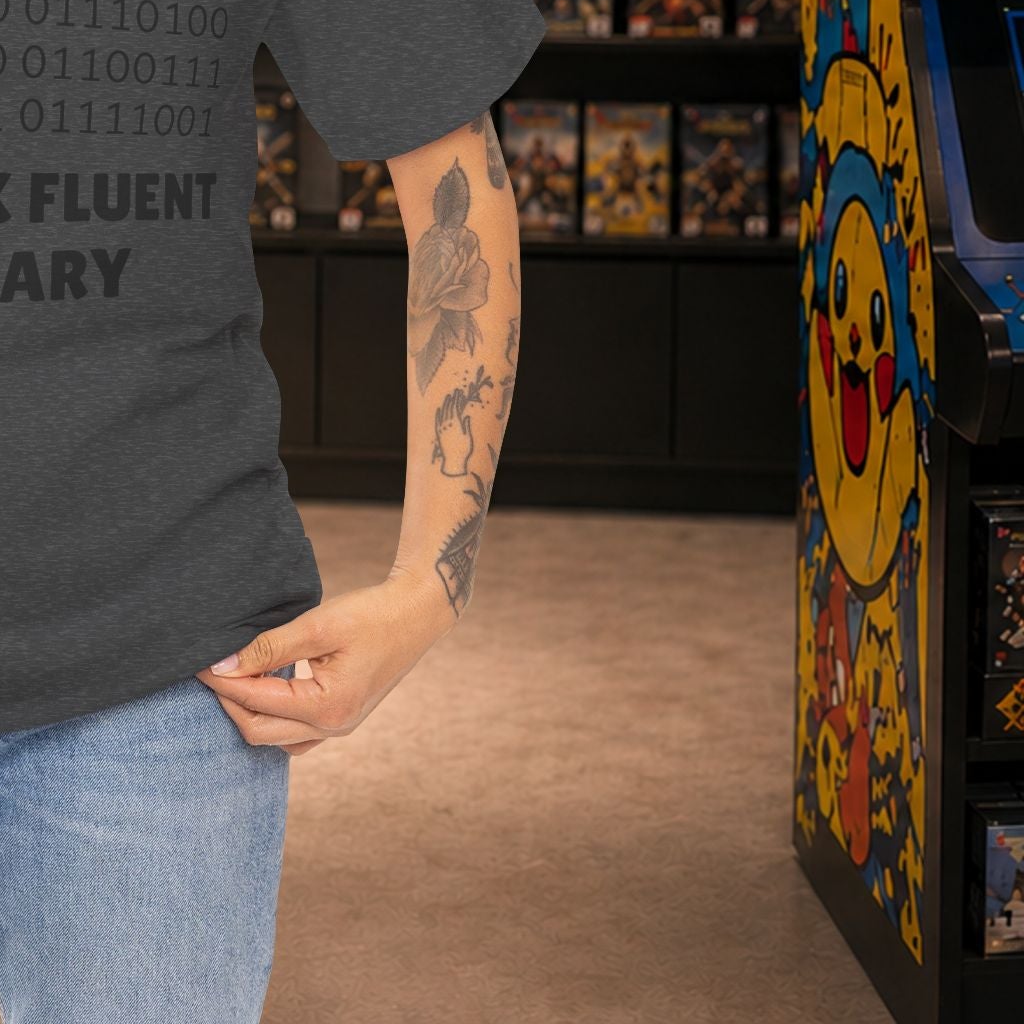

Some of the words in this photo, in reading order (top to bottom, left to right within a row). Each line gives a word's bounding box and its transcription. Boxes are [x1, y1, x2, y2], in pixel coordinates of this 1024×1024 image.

[21, 44, 222, 89] 01100111
[19, 98, 214, 137] 01111001
[29, 172, 217, 224] FLUENT
